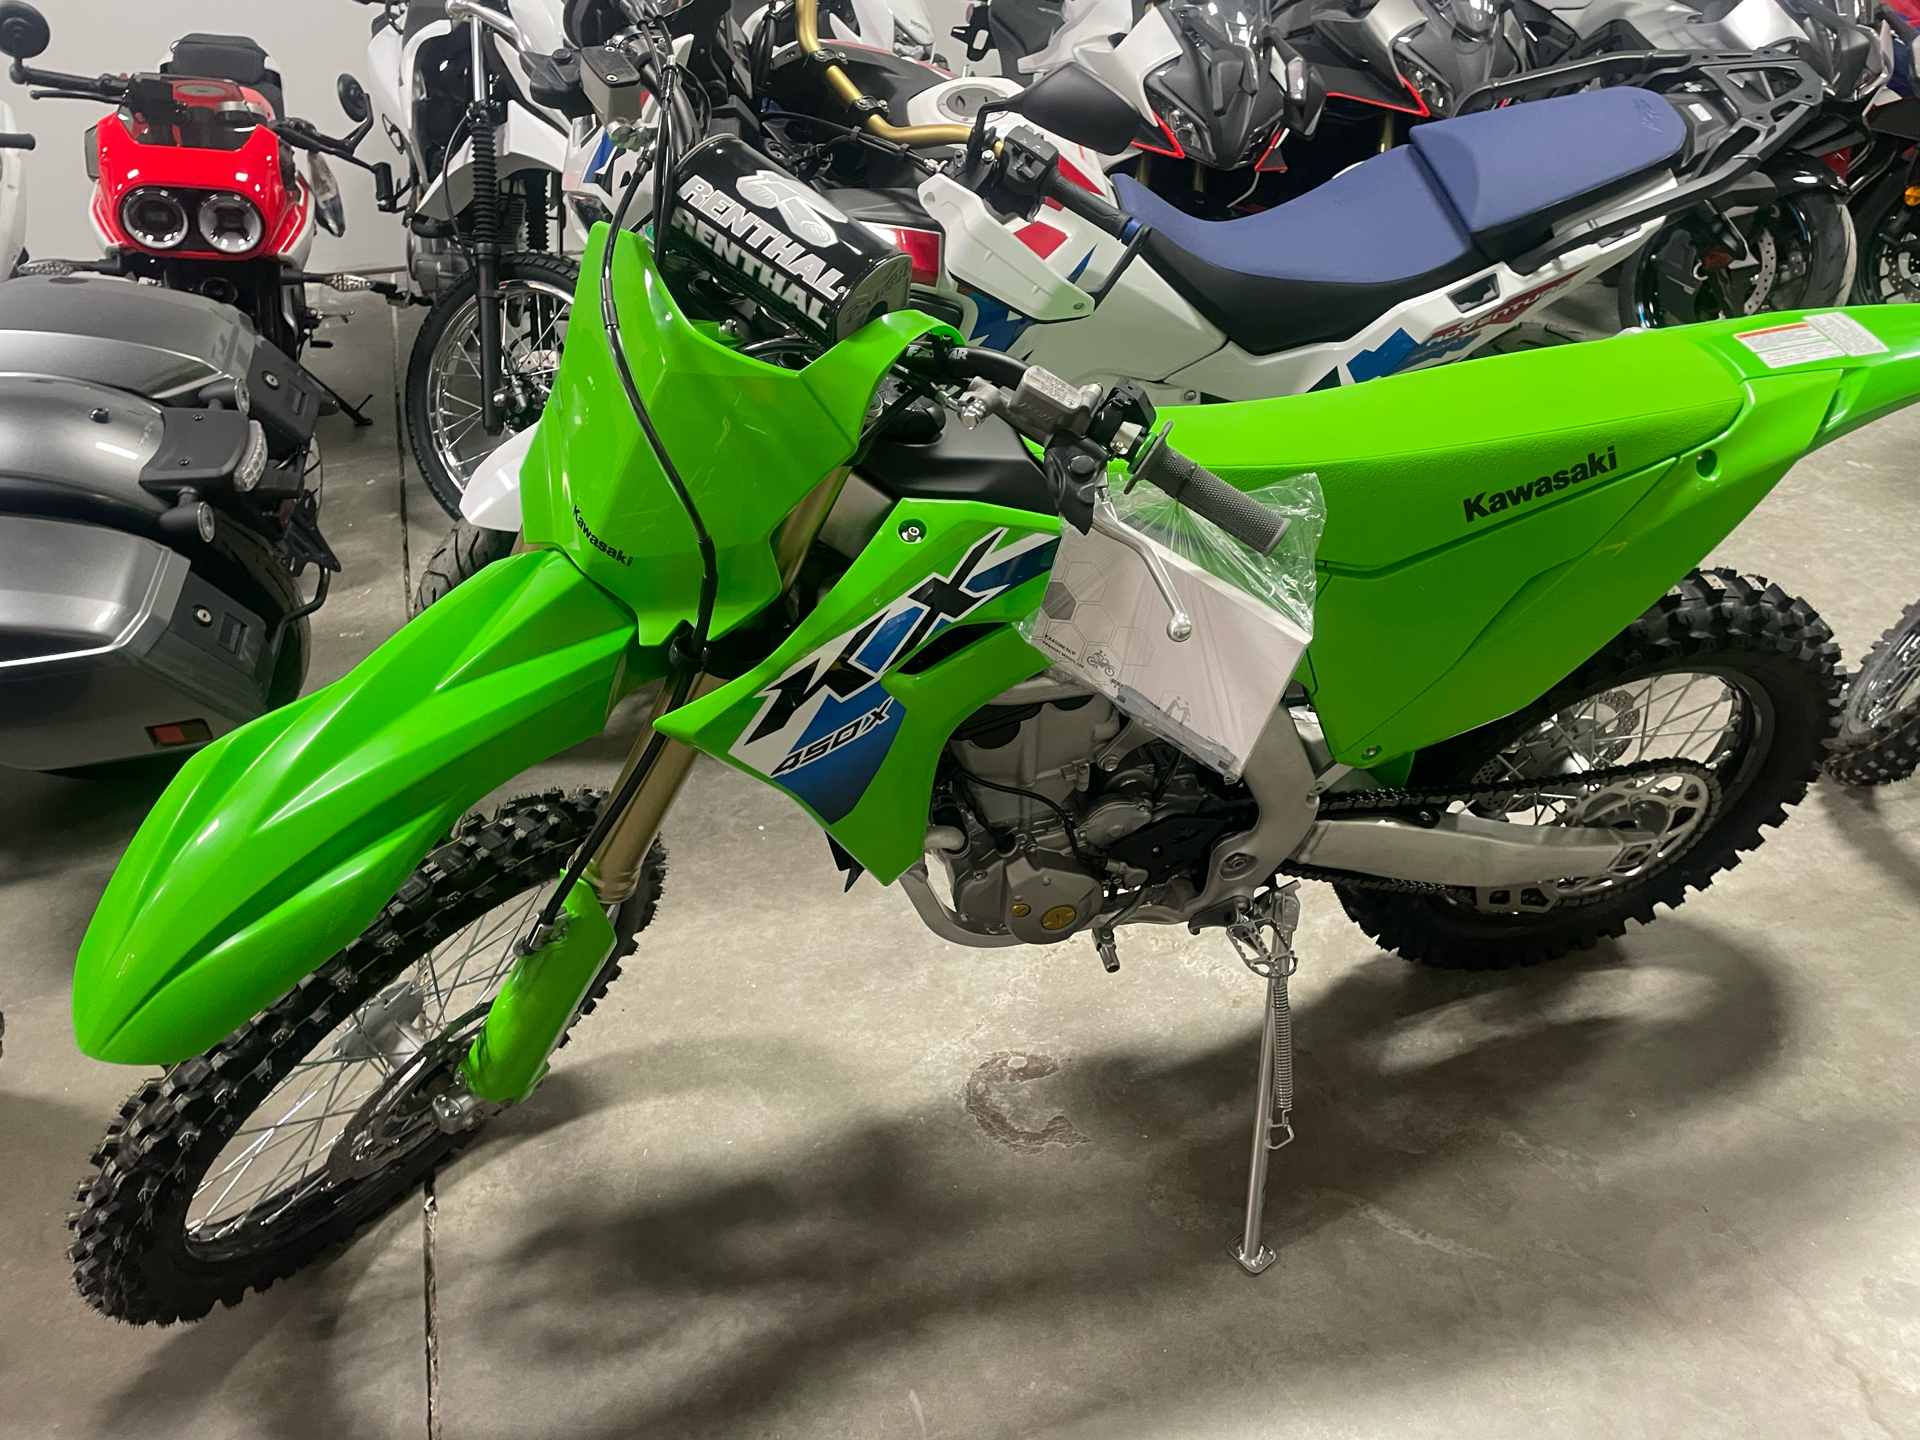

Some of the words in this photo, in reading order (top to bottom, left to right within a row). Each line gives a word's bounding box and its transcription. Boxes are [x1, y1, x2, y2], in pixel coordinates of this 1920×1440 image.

[906, 344, 968, 360] FAAR
[1463, 445, 1618, 523] Kawasaki
[572, 504, 634, 567] Kawasaki
[770, 696, 894, 778] 450X
